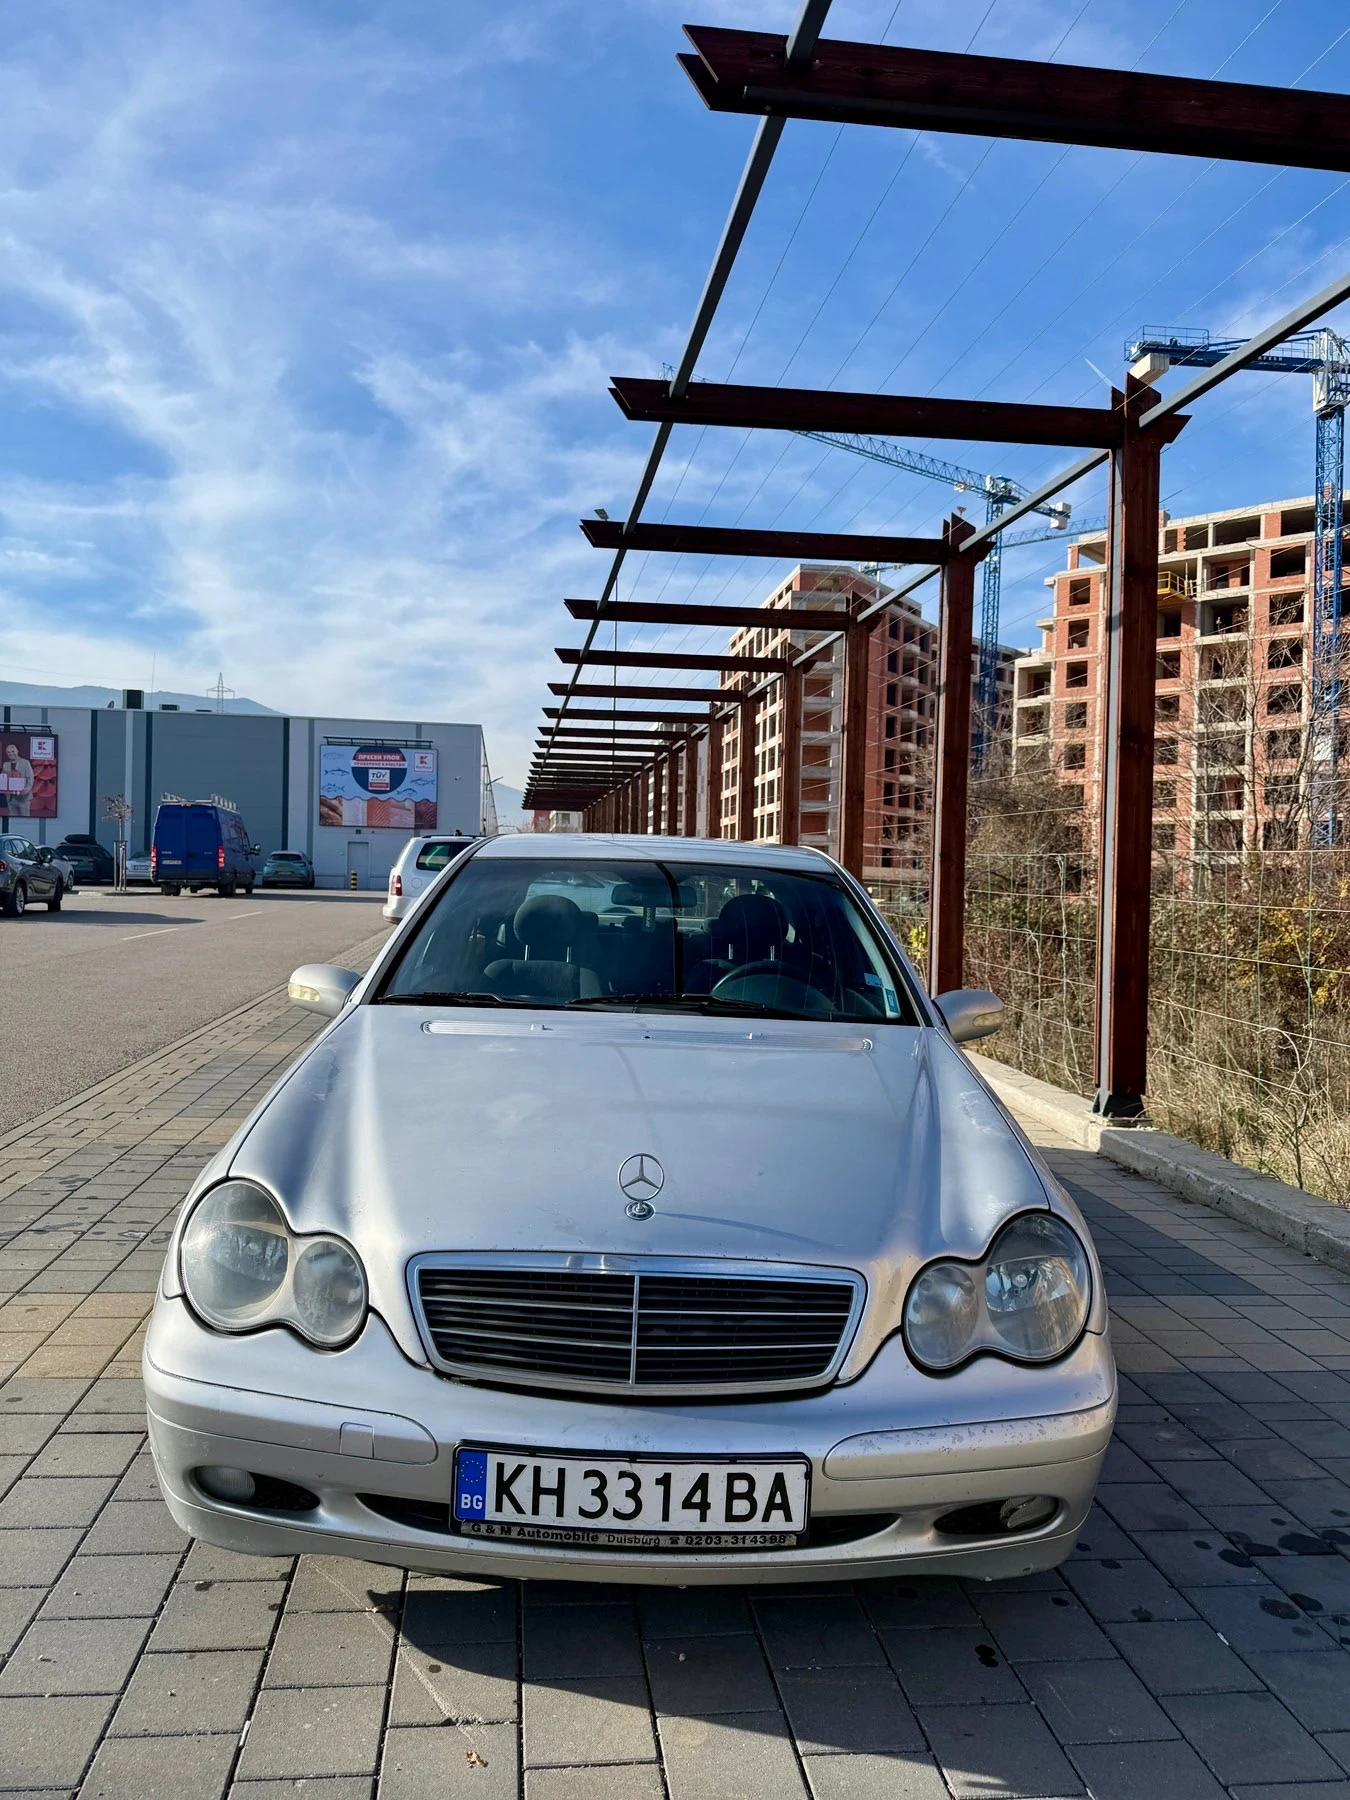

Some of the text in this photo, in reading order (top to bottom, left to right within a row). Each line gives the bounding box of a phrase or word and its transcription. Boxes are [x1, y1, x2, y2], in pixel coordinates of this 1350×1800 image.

[371, 771, 388, 779] TÜV
[461, 1494, 483, 1510] BG
[471, 1523, 481, 1533] G
[486, 1525, 496, 1534] &
[500, 1526, 512, 1536] M
[517, 1527, 599, 1542] Automobile
[607, 1534, 660, 1546] Duisburg
